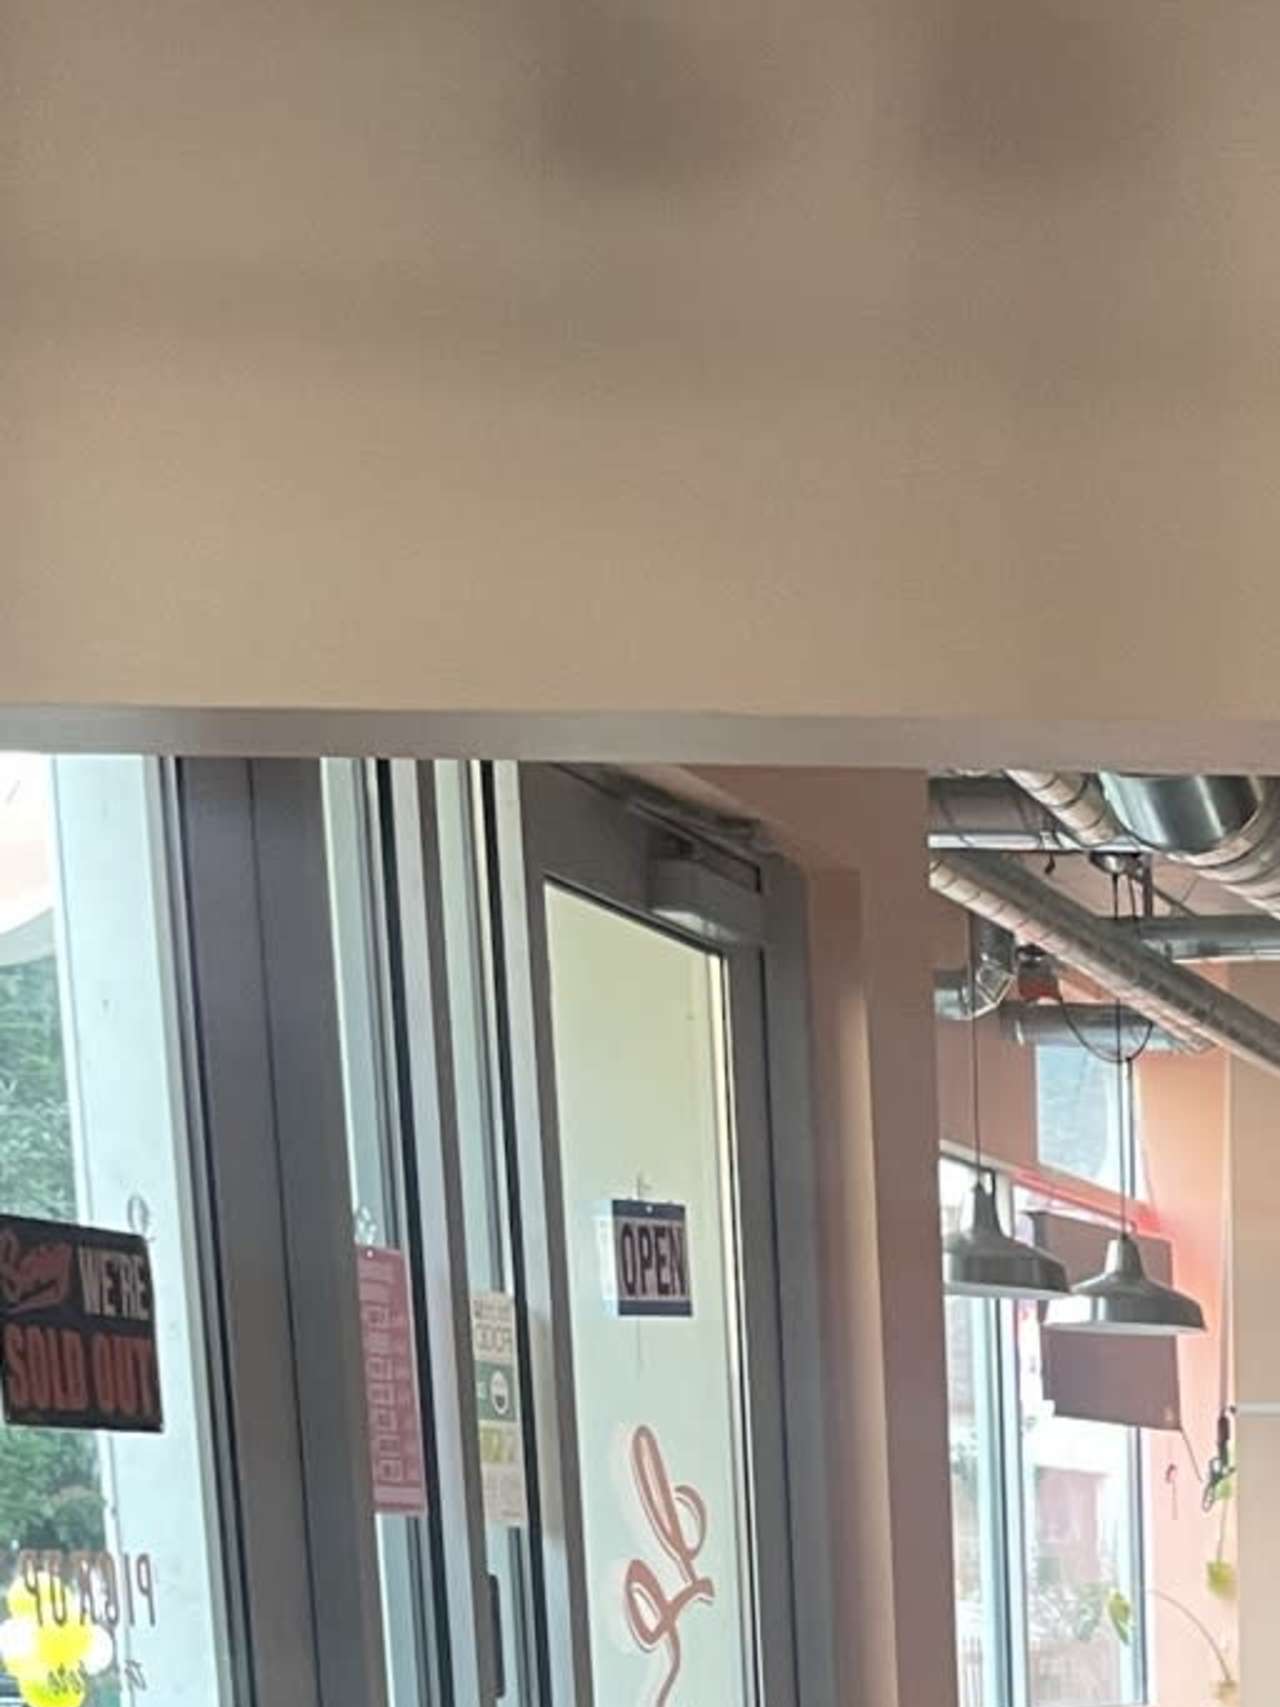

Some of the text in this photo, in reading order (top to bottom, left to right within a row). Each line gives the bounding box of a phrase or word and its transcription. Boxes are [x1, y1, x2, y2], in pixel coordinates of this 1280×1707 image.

[78, 1246, 149, 1321] WE'RE
[621, 1223, 686, 1296] OPEN
[5, 1321, 154, 1417] SOLD OUT
